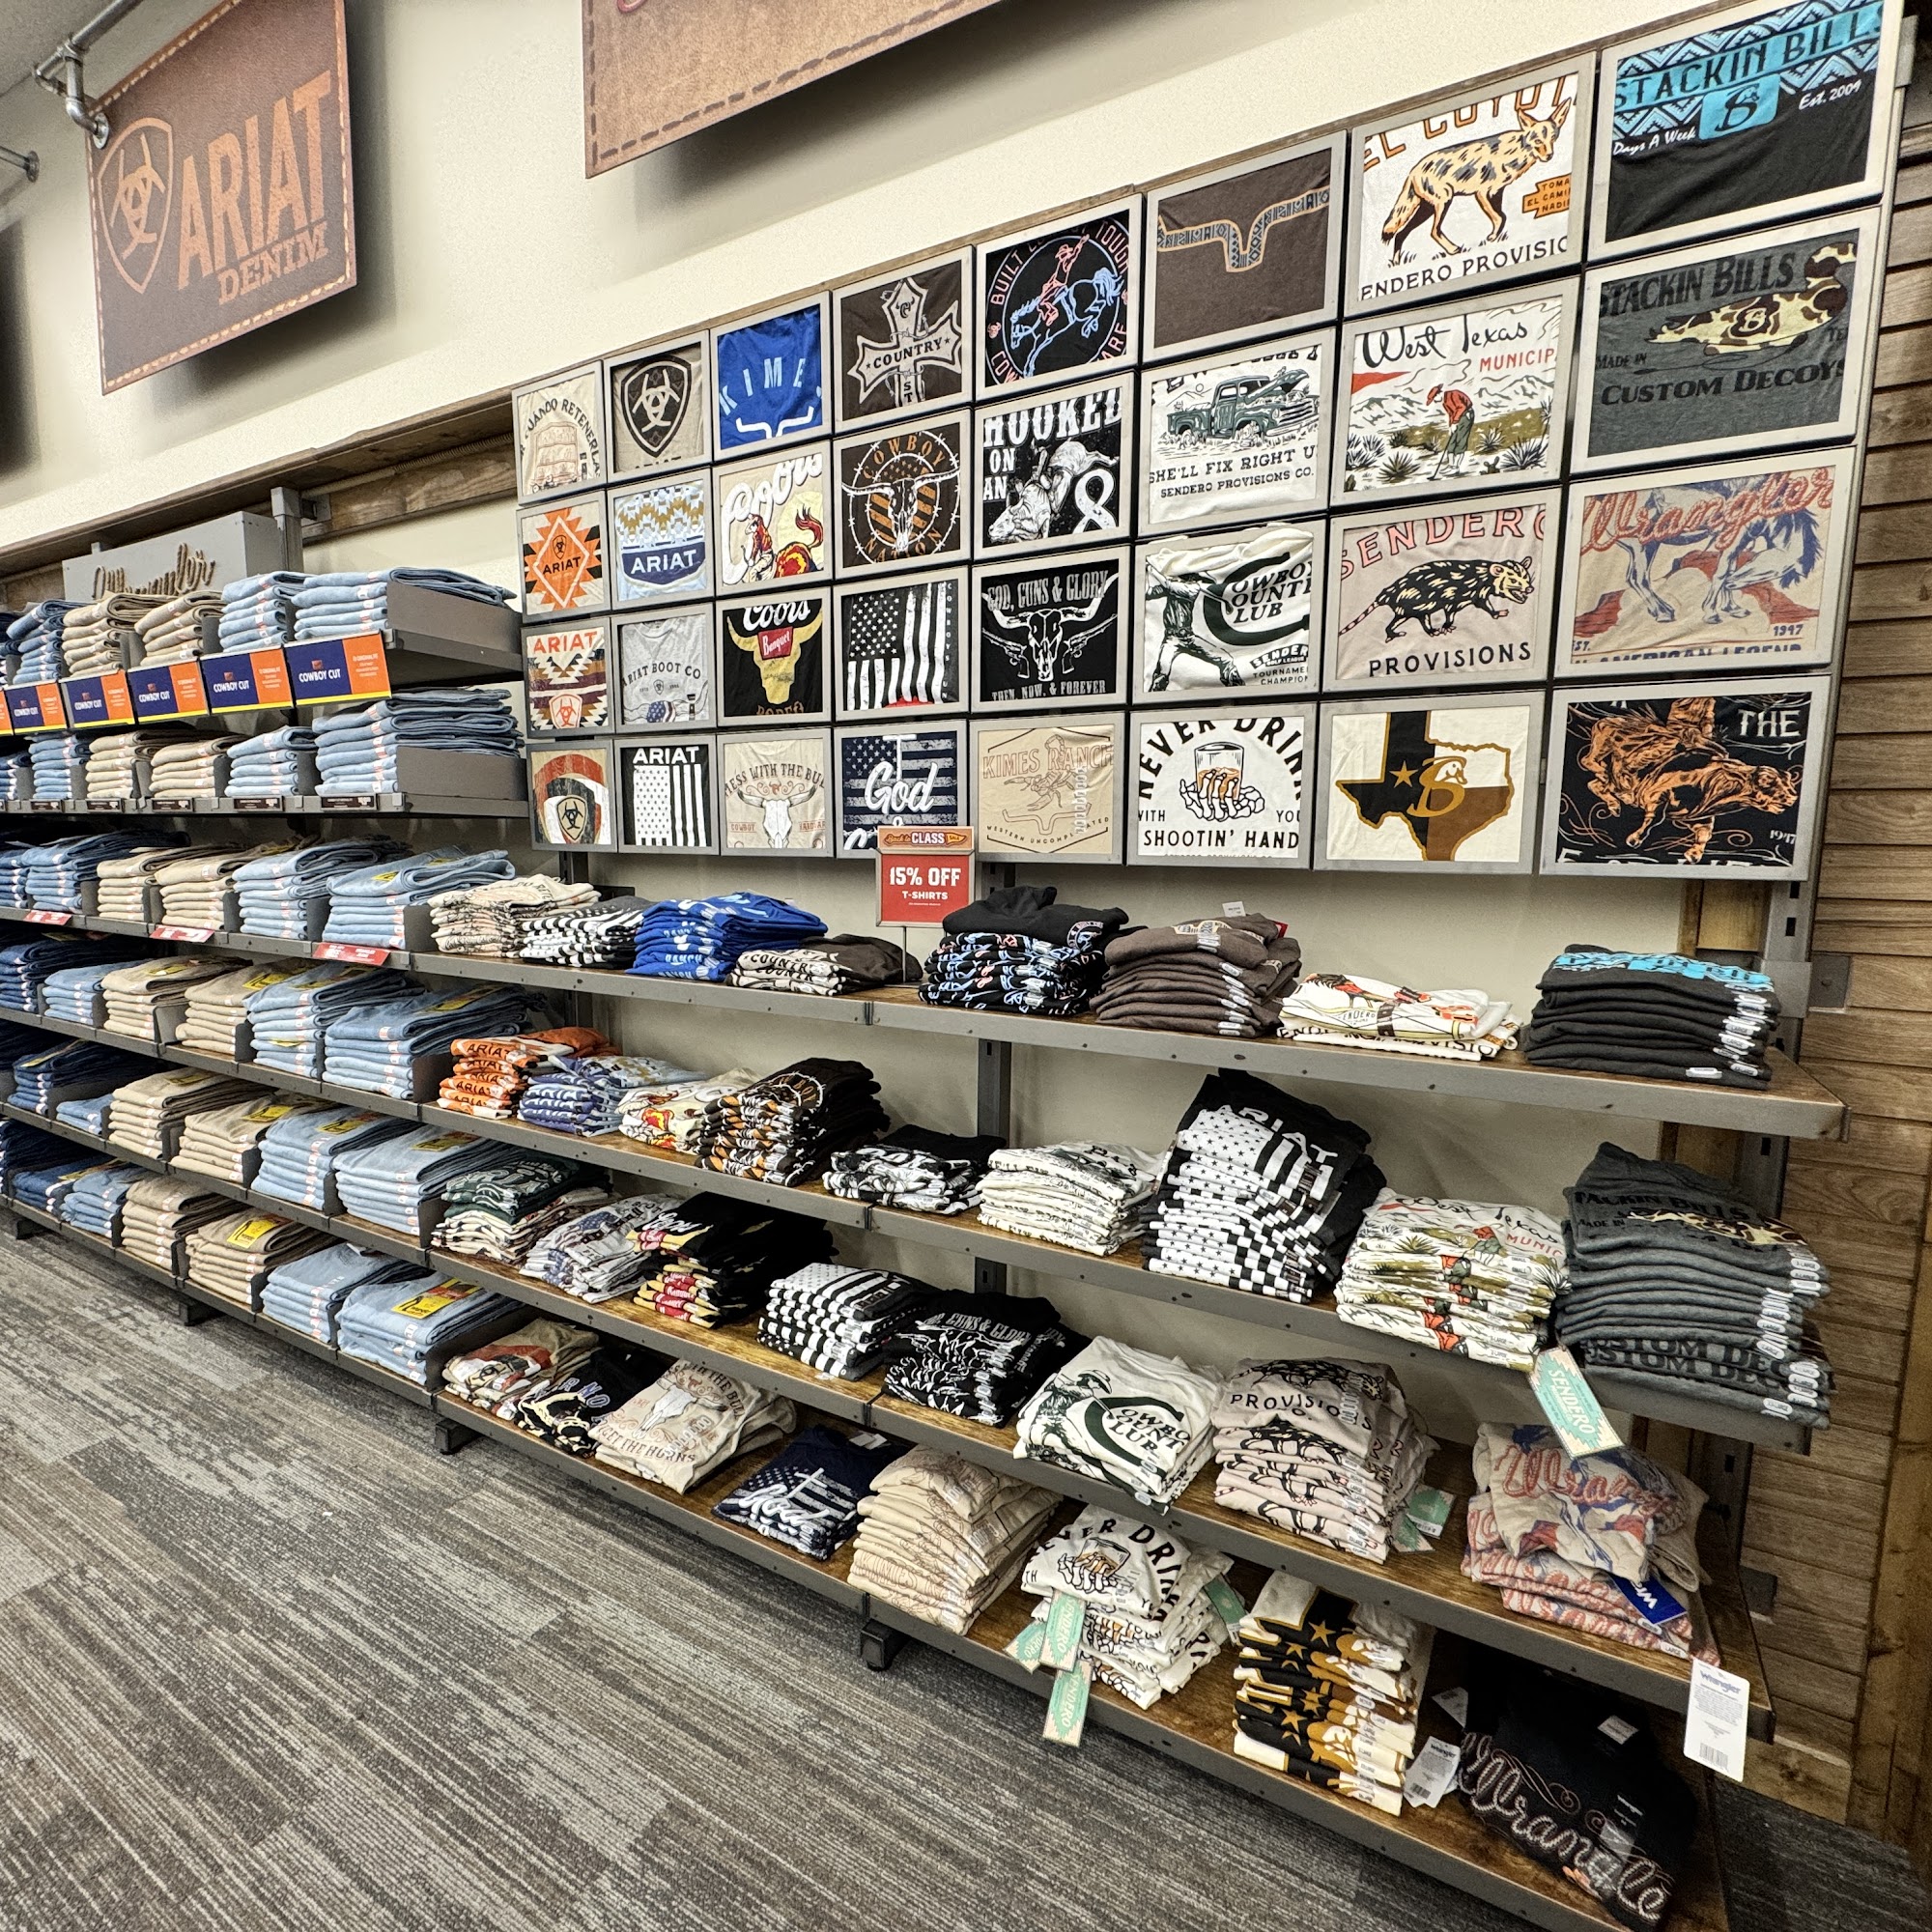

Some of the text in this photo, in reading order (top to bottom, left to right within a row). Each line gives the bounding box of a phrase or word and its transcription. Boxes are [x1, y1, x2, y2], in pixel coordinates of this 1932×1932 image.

[1614, 43, 1768, 109] STACKIN
[1613, 141, 1646, 156] Days
[1648, 133, 1661, 149] A
[178, 70, 332, 291] ARIAT
[1526, 188, 1572, 207] EL CAMI
[1542, 199, 1570, 212] NADI
[218, 221, 329, 306] DENIM
[990, 250, 1024, 306] BUILT
[872, 336, 943, 370] COUNTRY
[1361, 313, 1529, 369] West Texas
[1479, 348, 1557, 373] MUNICIP
[863, 434, 948, 480] COWBOY
[989, 447, 1015, 474] ON
[1206, 459, 1234, 476] FIX
[1240, 448, 1296, 470] RIGHT
[982, 475, 1008, 501] AN
[1160, 467, 1315, 498] SENDERO PROVISIONS CO.
[543, 555, 582, 576] ARIAT
[630, 549, 697, 576] ARIAT
[1017, 577, 1050, 610] GUNS
[1051, 575, 1063, 603] &
[1065, 569, 1109, 602] GLORY
[533, 630, 599, 655] ARIAT
[1773, 624, 1804, 638] 1947
[651, 661, 682, 674] BOOT
[684, 665, 702, 681] CO
[1369, 641, 1532, 678] PROVISIONS
[298, 669, 327, 684] COWBOY
[327, 668, 342, 680] CUT
[1253, 667, 1309, 679] TOURNAME
[138, 692, 161, 704] COWBOY
[212, 679, 250, 694] COWBOY CUT
[1049, 679, 1107, 696] & FOREVER
[1738, 707, 1802, 739] THE
[632, 746, 700, 765] ARIAT
[982, 744, 1114, 780] KIMES RANCH
[749, 763, 779, 781] WITH
[780, 762, 803, 778] THE
[864, 760, 939, 814] God
[911, 832, 945, 844] CLASS
[986, 816, 1110, 844] WESTERN UNCOMPLATED
[1143, 829, 1235, 848] SHOOTIN'
[889, 866, 962, 887] 15% OFF
[901, 890, 949, 900] T-SHIRTS
[1215, 1104, 1339, 1164] ARIAT
[1548, 1369, 1596, 1435] SENDERO
